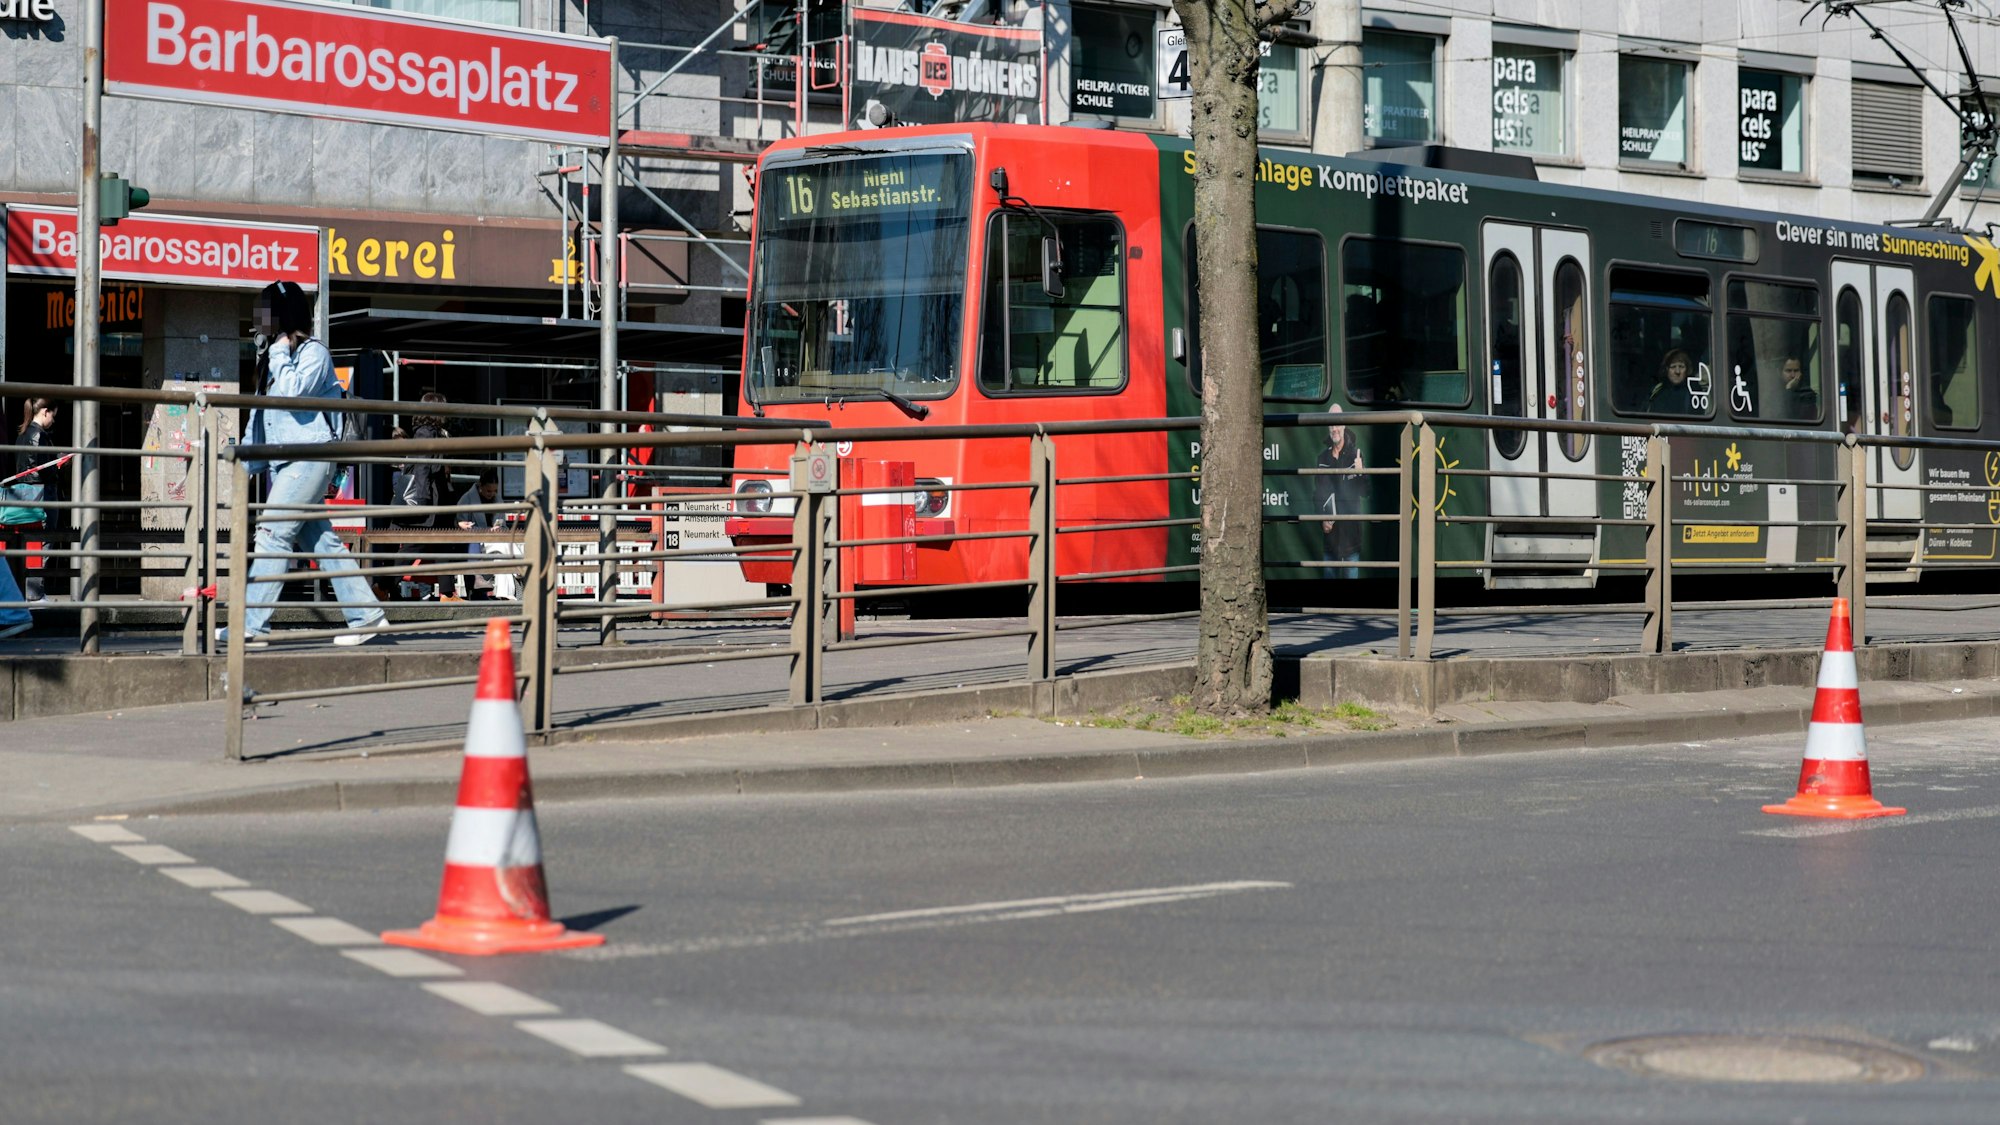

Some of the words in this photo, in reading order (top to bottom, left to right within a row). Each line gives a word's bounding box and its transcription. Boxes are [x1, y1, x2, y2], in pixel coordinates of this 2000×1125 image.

[146, 1, 579, 114] Barbarossaplatz
[857, 41, 919, 86] HAUS
[925, 61, 947, 81] DES
[953, 51, 1037, 98] DÖNERS
[1168, 50, 1191, 91] 4
[1494, 57, 1536, 87] para
[1076, 79, 1150, 96] HEILPRAKTIKER
[1076, 94, 1114, 108] SCHULE
[1494, 86, 1529, 115] cels
[1741, 88, 1777, 115] para
[1741, 112, 1772, 139] cels
[1622, 140, 1653, 153] SCHULE
[786, 174, 814, 214] 16
[831, 184, 942, 210] Sebastianstr.
[1317, 164, 1468, 204] Komplettpaket
[1706, 227, 1719, 254] 16
[1776, 220, 1822, 245] Clever
[1826, 226, 1847, 248] sin
[1851, 232, 1880, 251] met
[1882, 233, 1969, 267] Sunnesching
[1928, 468, 1940, 477] Wir
[1940, 469, 1957, 478] bauen
[1958, 469, 1970, 478] Ihre
[684, 502, 720, 511] Neumarkt
[1929, 493, 1957, 503] gesamten
[1958, 492, 1986, 502] Rheinland
[667, 533, 679, 547] 18
[684, 530, 720, 539] Neumarkt
[1707, 529, 1729, 538] Angebot
[1730, 529, 1754, 537] anfordern
[1928, 537, 1946, 547] Düren
[1950, 538, 1972, 547] Koblenz
